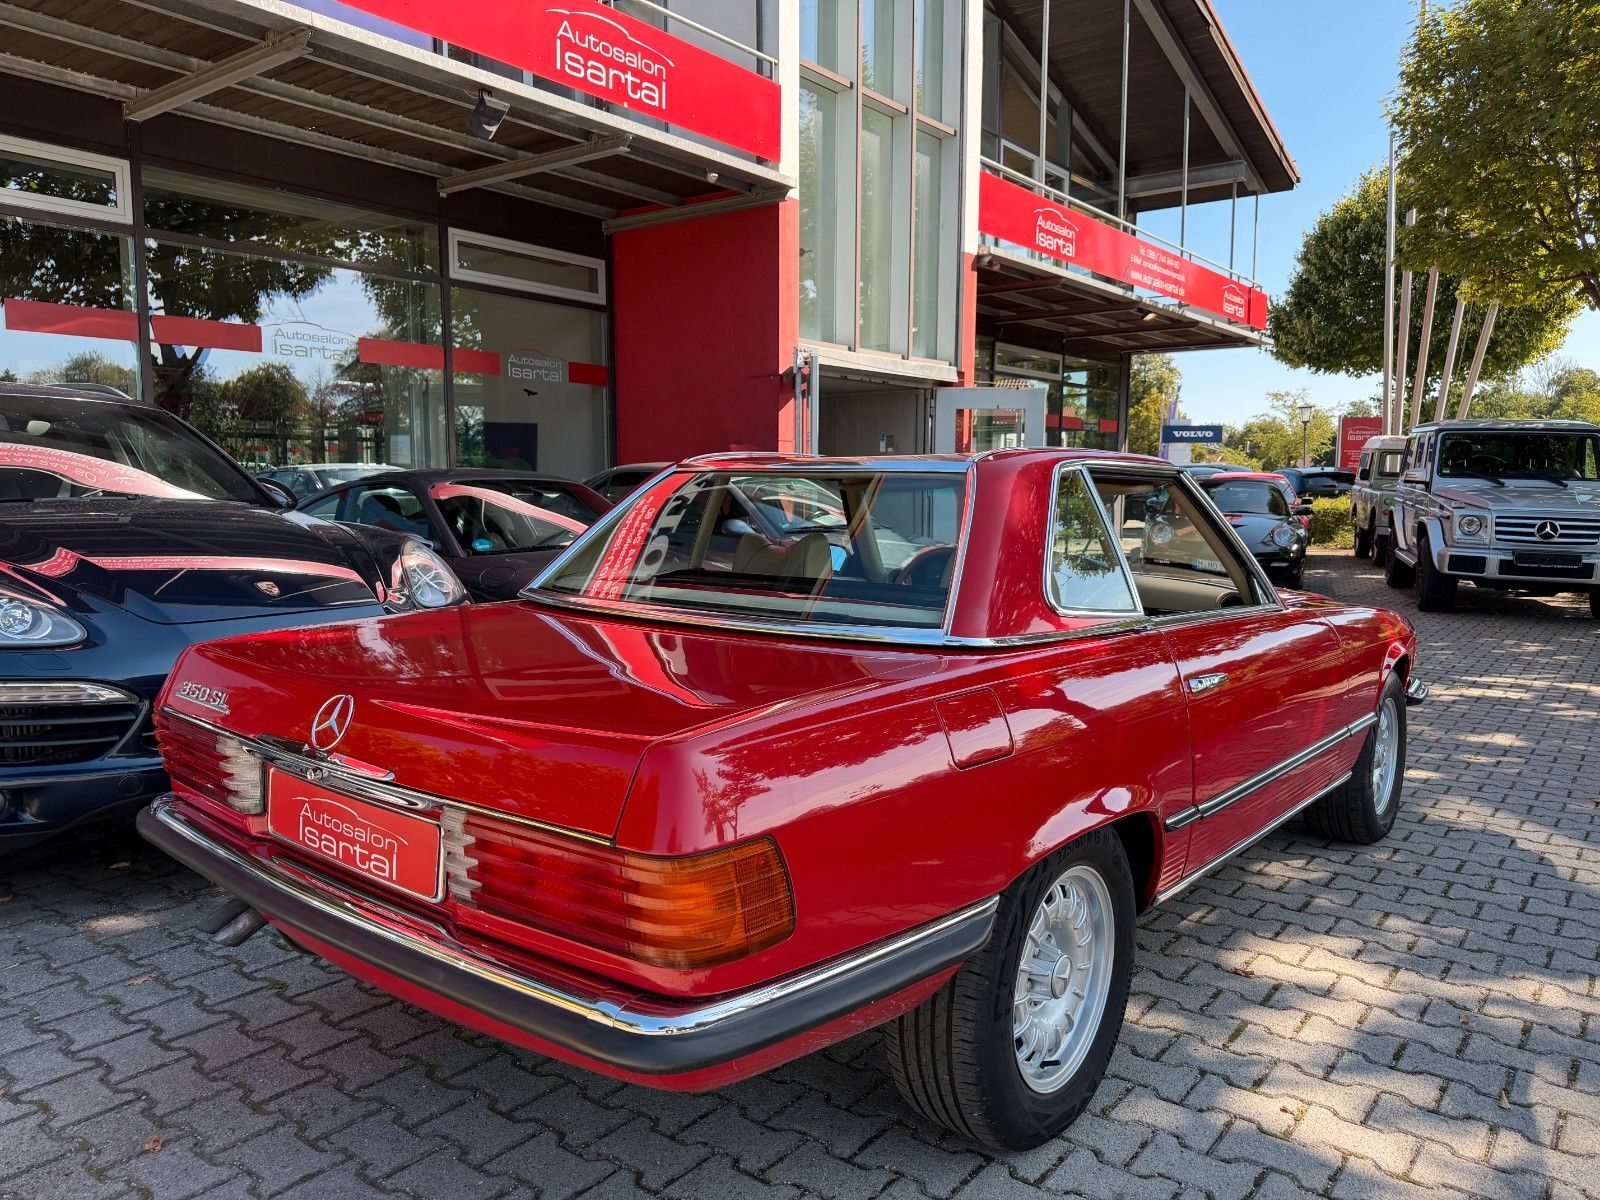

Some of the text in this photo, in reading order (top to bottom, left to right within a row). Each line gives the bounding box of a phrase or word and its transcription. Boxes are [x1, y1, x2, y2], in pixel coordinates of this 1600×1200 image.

[557, 20, 667, 80] Autosalon
[556, 38, 667, 110] Isartal
[1036, 215, 1076, 239] Autosalon
[1035, 226, 1075, 258] Isartal
[274, 328, 350, 346] Autosalon
[507, 363, 562, 382] Isartal
[508, 354, 562, 369] Autosalon
[1172, 430, 1213, 438] VOLVO
[180, 681, 229, 709] 350 SL
[299, 802, 398, 854] Autosalon
[299, 815, 398, 881] Isartal
